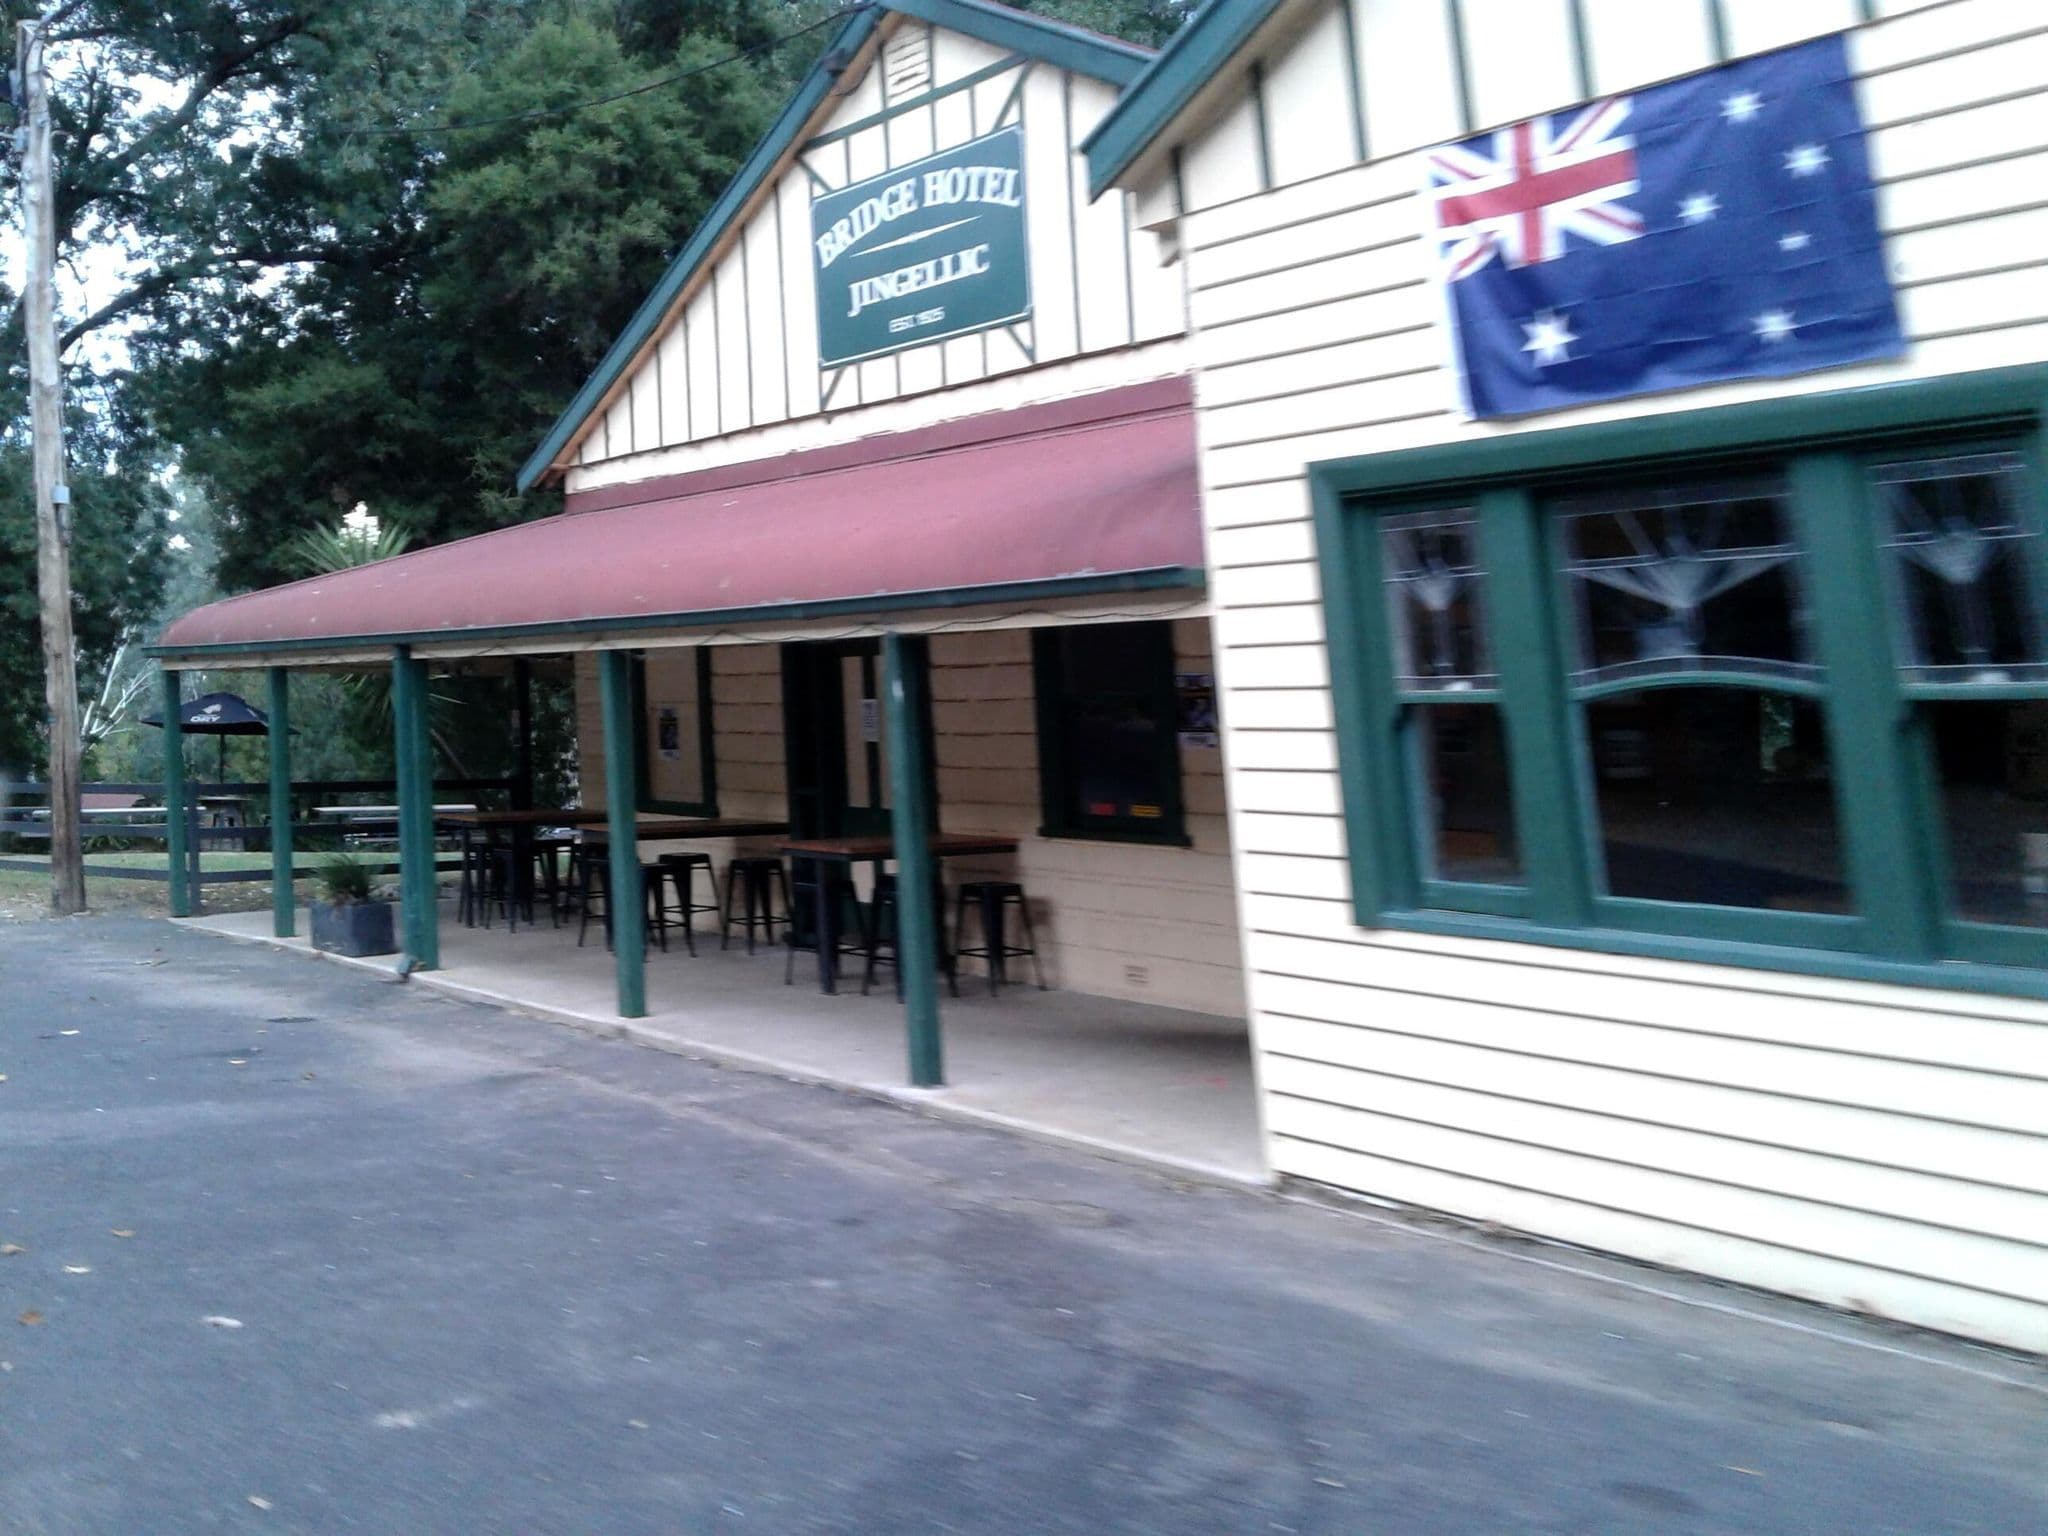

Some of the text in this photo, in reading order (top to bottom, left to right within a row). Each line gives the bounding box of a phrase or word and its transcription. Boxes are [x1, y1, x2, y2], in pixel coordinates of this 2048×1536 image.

[815, 166, 1021, 269] BRIDGE HOTEL
[847, 243, 990, 318] JINGELLIC
